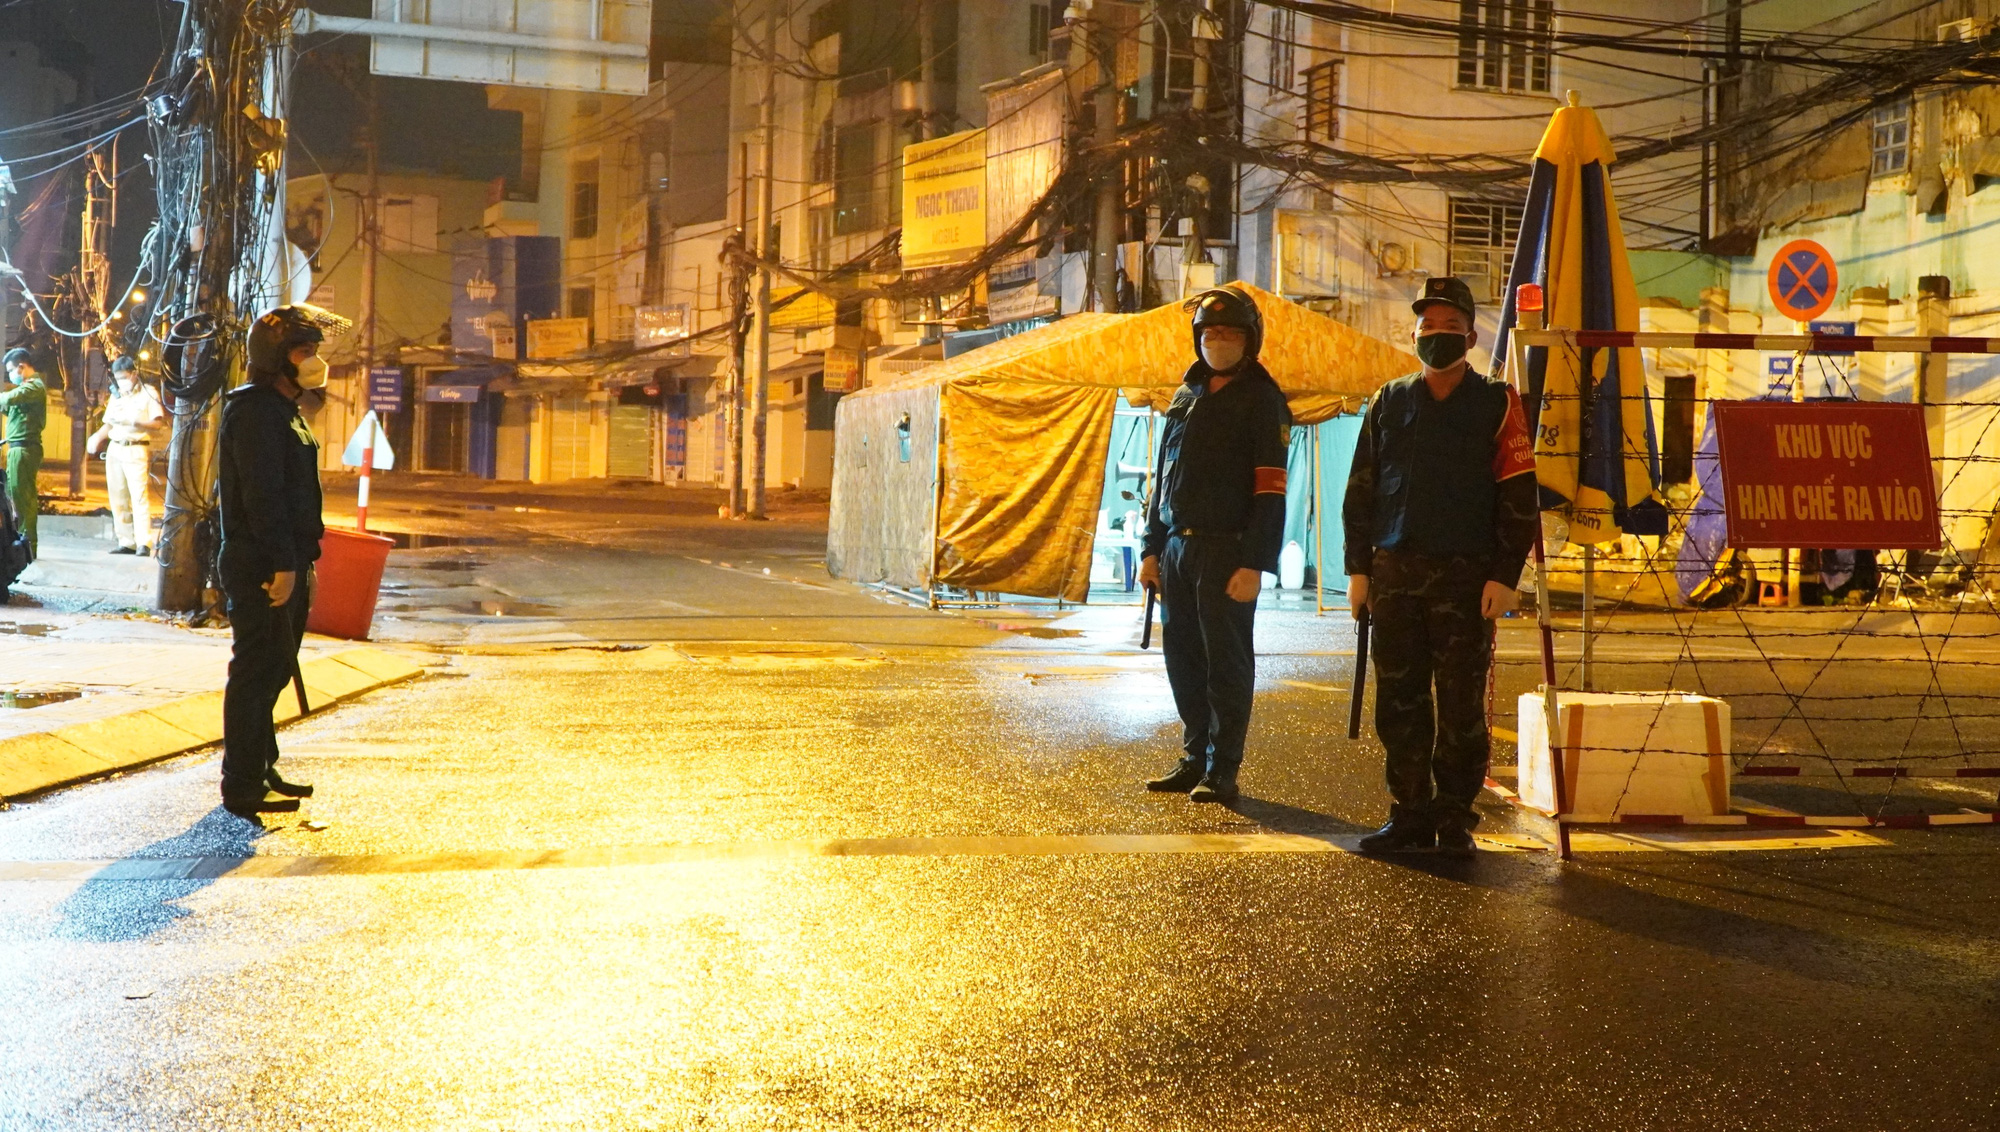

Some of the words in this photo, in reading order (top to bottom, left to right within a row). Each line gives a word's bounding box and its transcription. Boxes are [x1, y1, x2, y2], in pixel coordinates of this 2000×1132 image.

[1775, 424, 1823, 459] KHU
[1827, 421, 1873, 467] VỰC
[1737, 485, 1787, 528] HẠN
[1792, 474, 1838, 521] CHẾ
[1843, 486, 1875, 521] RA
[1878, 478, 1924, 521] VÀO
